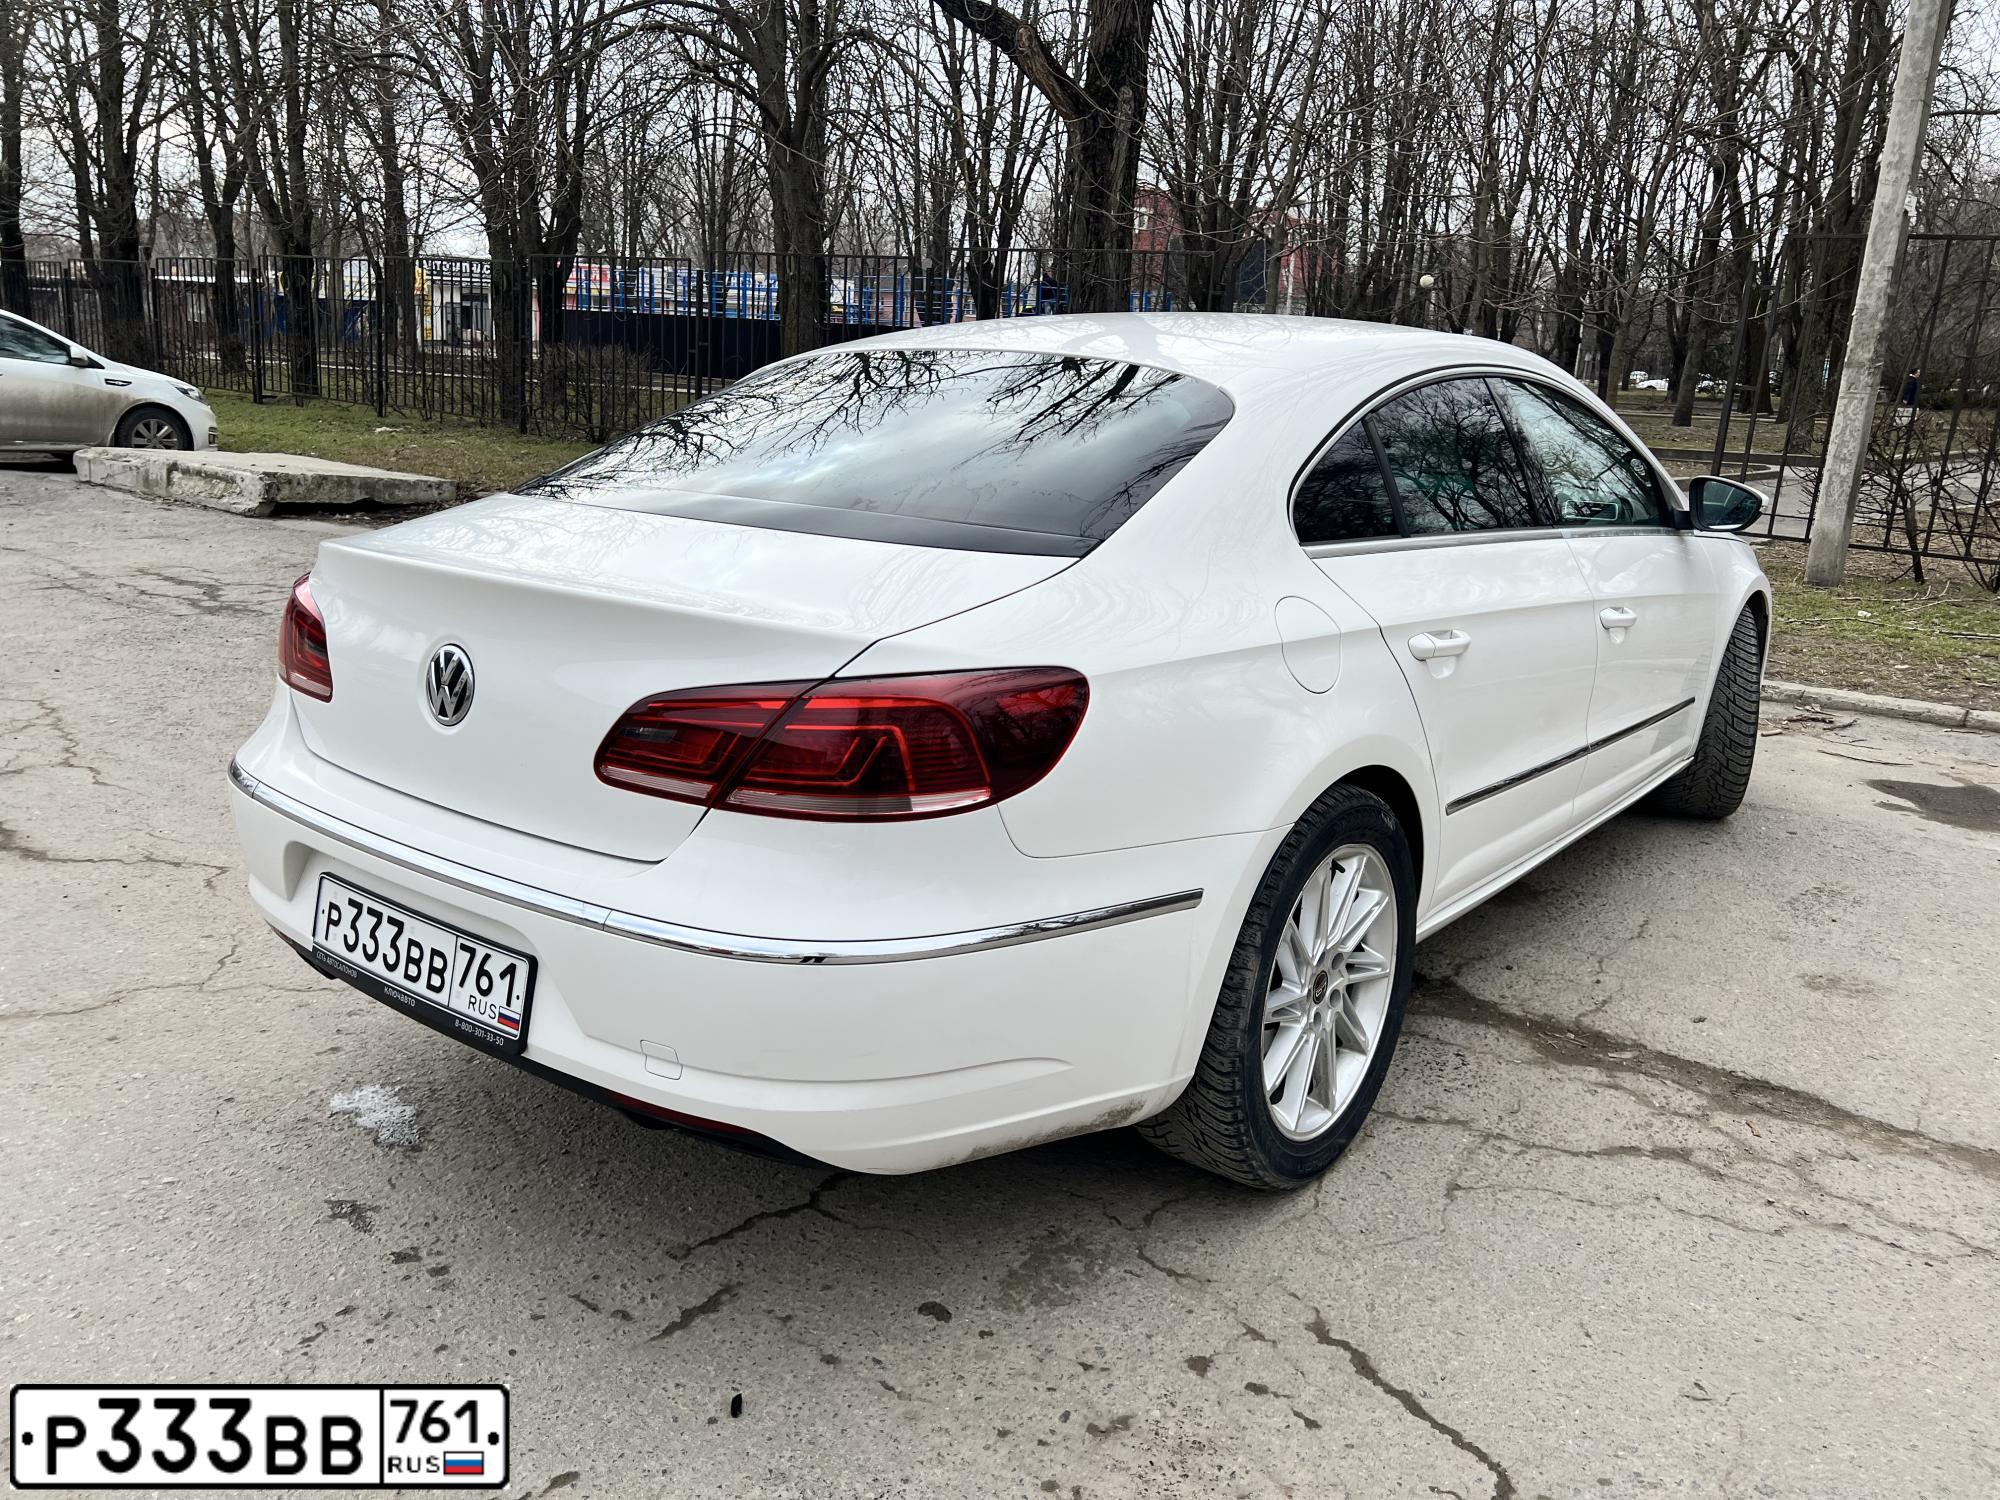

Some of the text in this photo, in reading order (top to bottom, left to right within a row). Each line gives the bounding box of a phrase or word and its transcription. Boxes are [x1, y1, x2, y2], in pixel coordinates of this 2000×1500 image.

[327, 957, 358, 979] АВТОСАЛОНОВ
[458, 942, 518, 1008] 761
[467, 995, 497, 1020] RUS
[454, 1019, 505, 1047] 8-800-301-33-50
